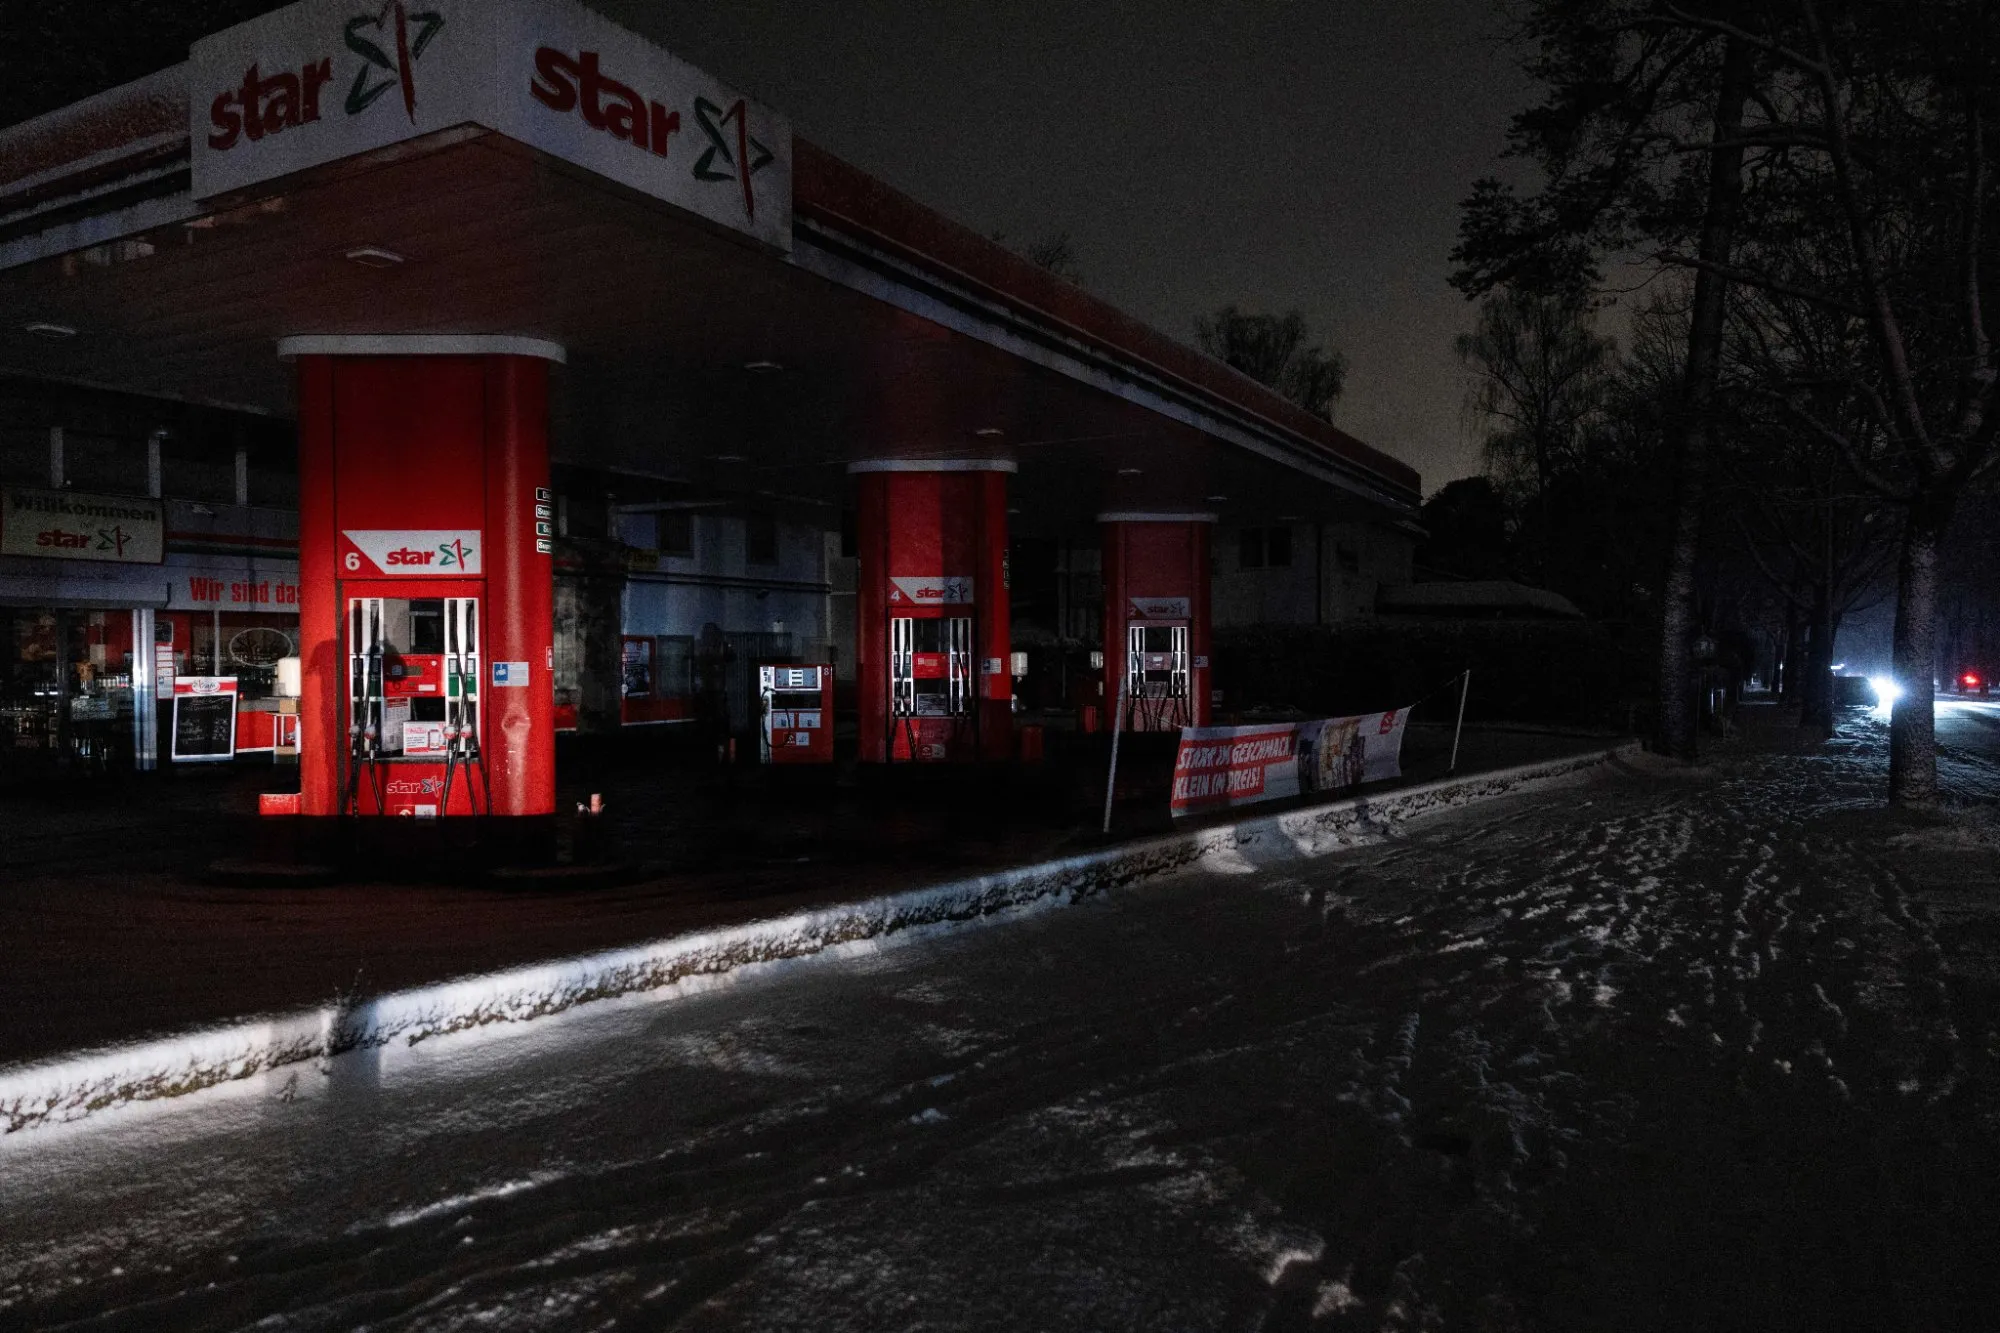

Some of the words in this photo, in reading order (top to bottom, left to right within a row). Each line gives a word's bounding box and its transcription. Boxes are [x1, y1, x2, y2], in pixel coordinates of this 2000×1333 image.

[207, 57, 332, 151] star
[529, 46, 680, 158] star
[11, 492, 156, 521] Willkommen
[35, 529, 92, 549] star
[344, 552, 361, 571] 6
[386, 547, 435, 566] star
[189, 576, 224, 602] Wir
[231, 579, 269, 603] sind
[890, 590, 901, 601] 4
[916, 587, 945, 599] star
[1147, 604, 1169, 614] star
[823, 667, 830, 676] 8
[1177, 747, 1216, 770] STARK
[1215, 743, 1233, 767] IM
[386, 779, 421, 794] star
[1173, 773, 1210, 800] KLEIN
[1211, 771, 1227, 795] IM
[1226, 766, 1261, 793] PREIS!
